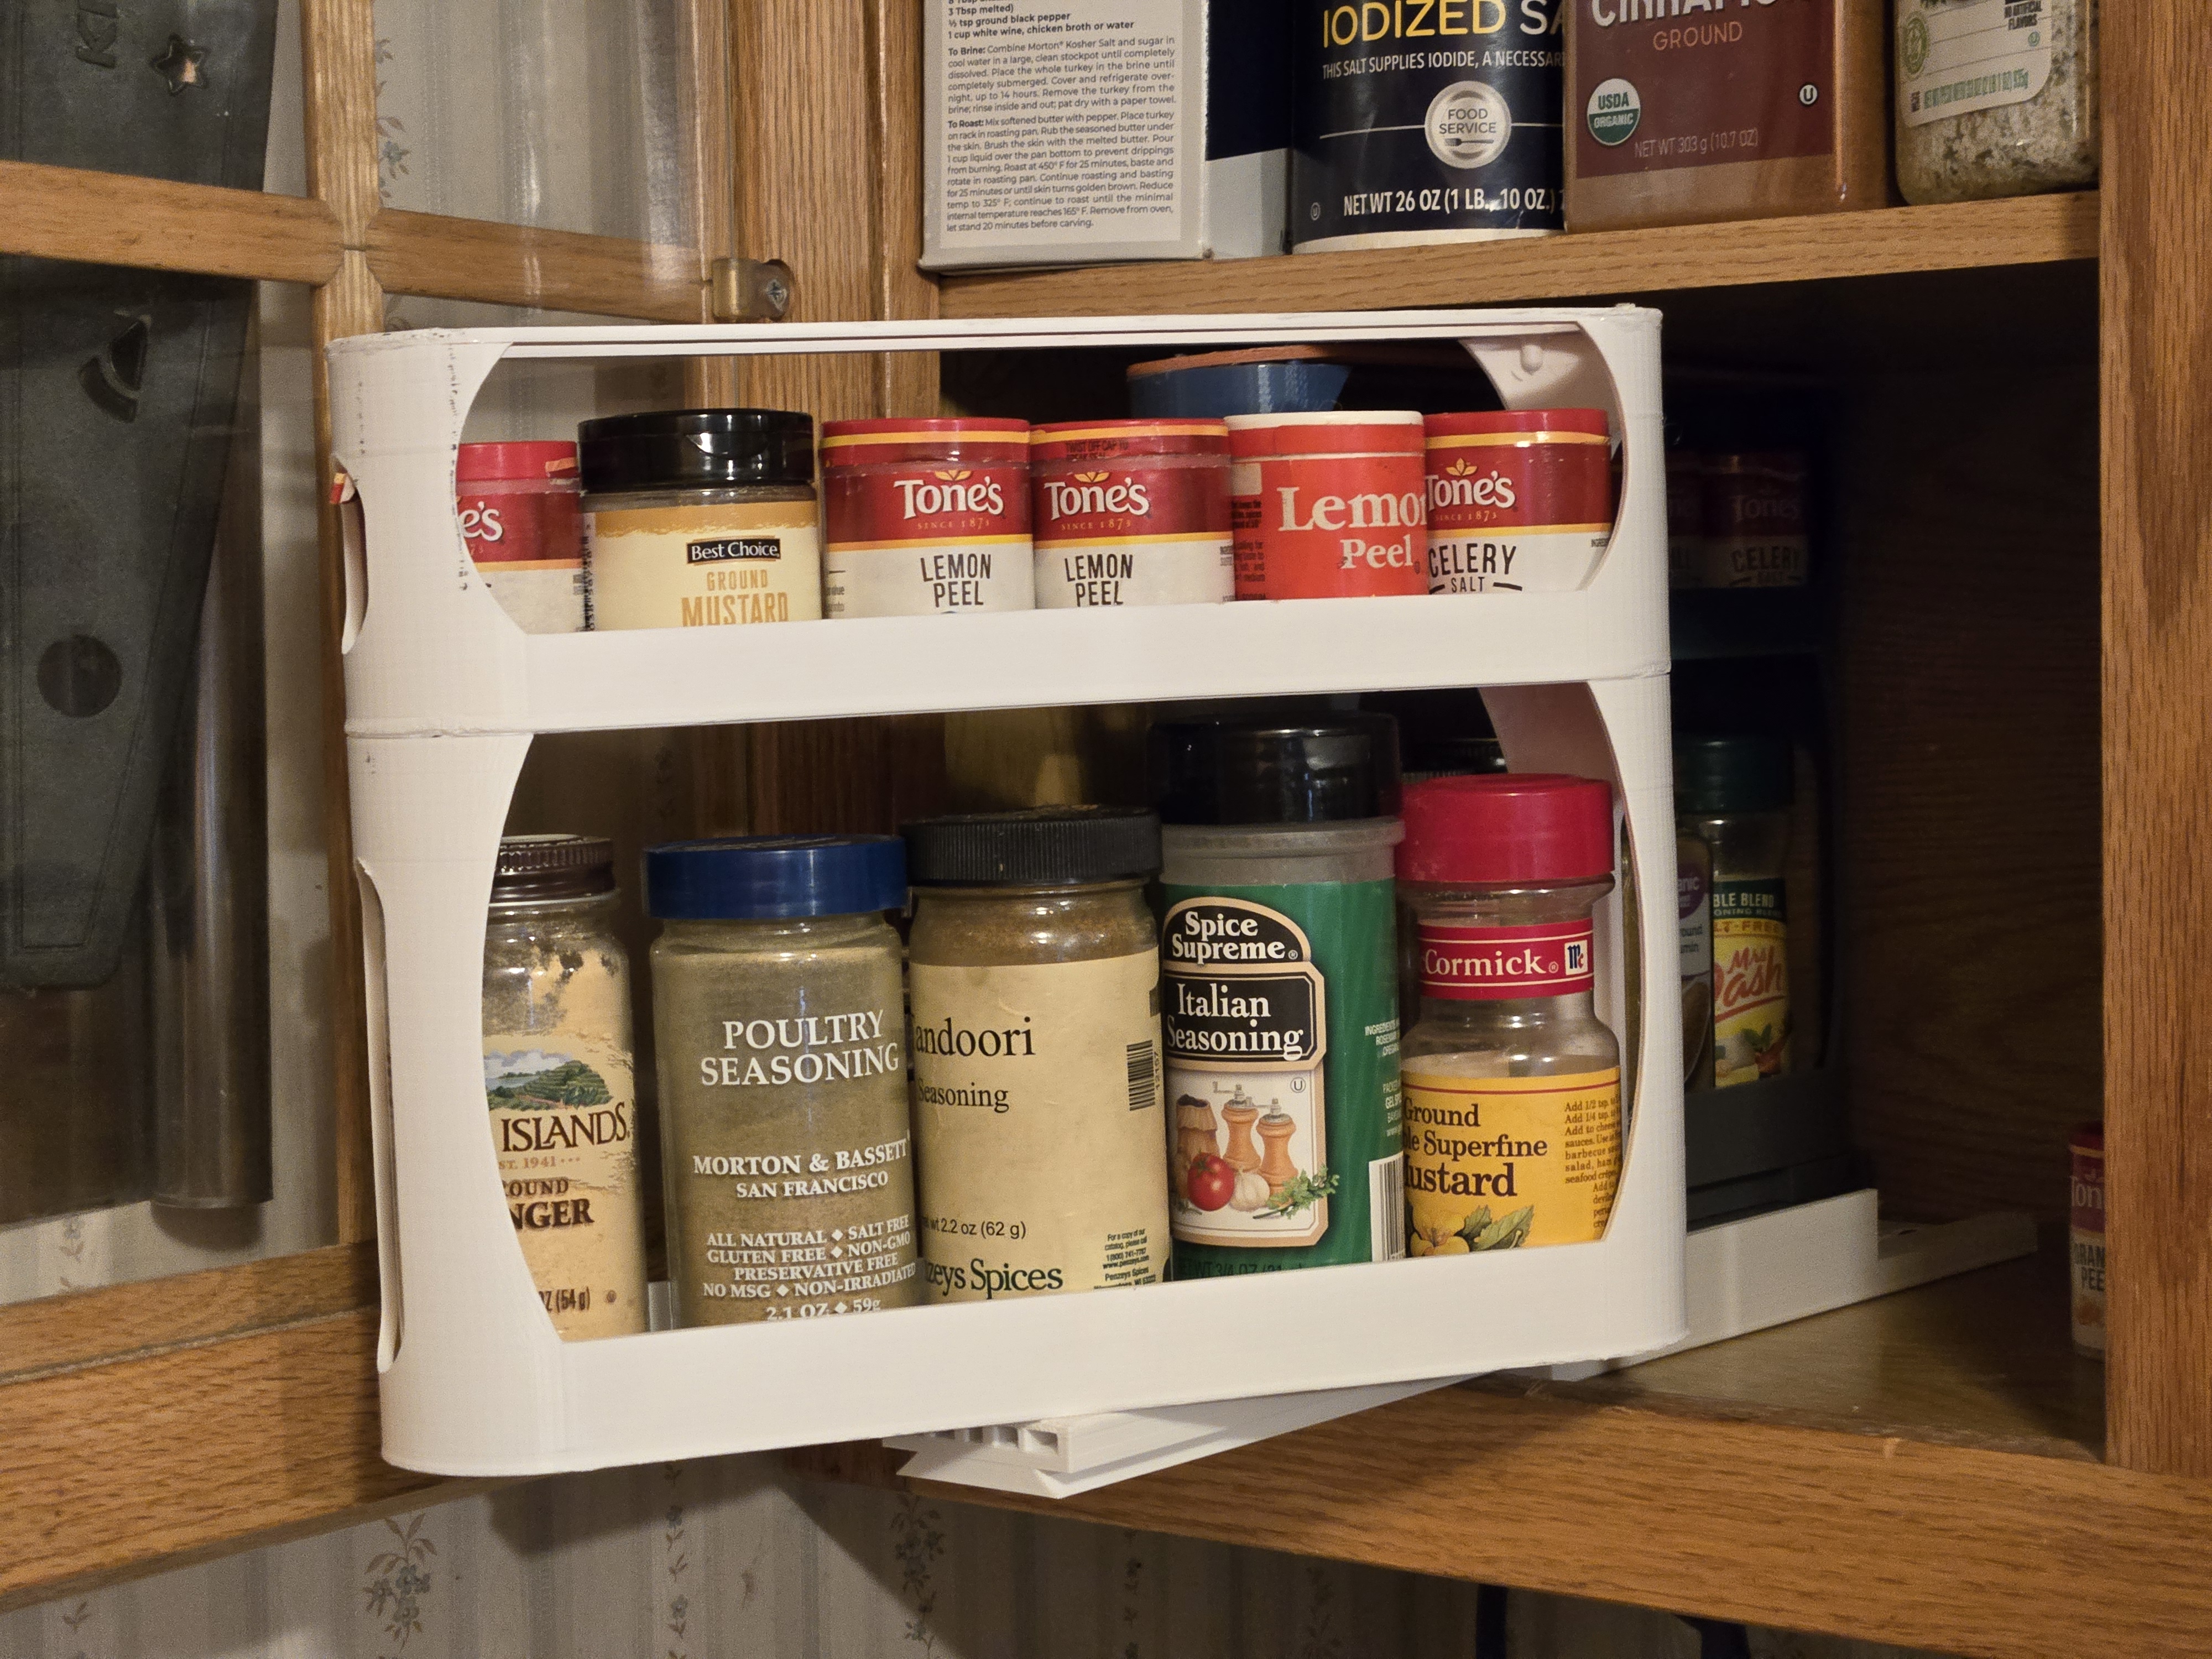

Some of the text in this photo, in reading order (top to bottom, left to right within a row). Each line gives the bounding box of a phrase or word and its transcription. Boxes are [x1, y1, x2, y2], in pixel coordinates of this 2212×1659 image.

[956, 7, 977, 15] Tbsp
[979, 3, 1014, 13] melted)
[976, 15, 1008, 27] ground
[1011, 14, 1035, 23] black
[1037, 13, 1072, 23] pepper
[973, 28, 998, 37] white
[1000, 27, 1025, 35] wine,
[1027, 24, 1062, 34] chicken
[1066, 23, 1091, 32] broth
[1324, 0, 1506, 48] IODIZED
[1652, 21, 1743, 51] GROUND
[948, 48, 958, 56] To
[961, 46, 985, 55] Brine:
[987, 44, 1025, 54] Combine
[1066, 39, 1096, 49] Kosher
[1099, 38, 1115, 48] Salt
[1118, 37, 1135, 46] and
[1138, 36, 1163, 47] sugar
[1166, 35, 1175, 44] in
[948, 59, 965, 67] cool
[967, 58, 990, 66] water
[993, 56, 1000, 65] in
[1010, 56, 1034, 65] large,
[1035, 54, 1058, 62] clean
[1061, 51, 1099, 61] stockpot
[1102, 49, 1121, 58] until
[1124, 47, 1175, 59] completely
[1323, 64, 1342, 80] THIS
[1344, 61, 1365, 77] SALT
[1369, 53, 1424, 72] SUPPLIES
[1429, 51, 1478, 69] IODIDE,
[1483, 51, 1492, 65] A
[1598, 91, 1630, 109] USDA
[1448, 108, 1488, 121] FOOD
[1593, 114, 1634, 129] ORGANIC
[1439, 122, 1496, 135] SERVICE
[1635, 127, 1759, 158] NET WT 303 g (10.7 OZ)
[1344, 192, 1366, 216] NET
[1370, 191, 1392, 213] WT
[1396, 191, 1415, 212] 26
[1420, 190, 1441, 211] OZ
[1444, 189, 1459, 215] (1
[1500, 188, 1520, 210] 10
[1524, 188, 1555, 213] OZ.)
[958, 222, 981, 231] stand
[983, 222, 993, 230] 20
[995, 221, 1029, 229] minutes
[1030, 219, 1057, 228] before
[1060, 218, 1094, 228] carving.
[893, 476, 1005, 520] Tone's
[1044, 477, 1152, 521] Tone's
[1426, 471, 1516, 512] Tone's
[457, 500, 504, 542] e's
[917, 521, 954, 530] SINCE
[1061, 521, 1094, 531] SINCE
[691, 539, 779, 560] Best Choice
[1340, 534, 1414, 570] Peel
[1428, 544, 1517, 578] CELERY
[706, 570, 768, 592] GROUND
[920, 554, 992, 582] LEMON
[1065, 554, 1134, 583] LEMON
[933, 581, 984, 607] PEEL
[1076, 582, 1124, 607] PEEL
[1451, 577, 1485, 594] SALT
[681, 592, 789, 628] MUSTARD
[1740, 893, 1775, 908] BLEND
[1185, 911, 1259, 941] Spice
[1172, 933, 1286, 965] Supreme
[1425, 948, 1547, 977] Cormick
[1177, 983, 1271, 1018] Italian
[722, 1009, 884, 1050] POULTRY
[915, 1015, 1036, 1057] andoori
[1167, 1015, 1304, 1061] Seasoning
[700, 1042, 899, 1086] SEASONING
[917, 1077, 1010, 1114] Seasoning
[1564, 1100, 1583, 1112] Add
[1585, 1099, 1597, 1110] 1/2
[1404, 1098, 1481, 1128] Ground
[1564, 1113, 1583, 1124] Add
[1564, 1125, 1595, 1136] Add to
[1423, 1134, 1548, 1161] Superfine
[1564, 1148, 1606, 1160] barbecue
[524, 1155, 556, 1169] 1941
[692, 1155, 801, 1176] MORTON
[808, 1152, 830, 1173] &
[1564, 1160, 1594, 1172] salad,
[736, 1170, 889, 1199] SAN FRANCISCO
[1564, 1170, 1597, 1183] seafood
[707, 1214, 910, 1248] ALL NATURAL SALT FREE
[941, 1218, 959, 1234] 2.2
[961, 1223, 978, 1235] oz
[980, 1220, 1005, 1239] (62
[1010, 1220, 1027, 1239] g)
[707, 1230, 911, 1265] GLUTEN FREE NON-GMO
[734, 1252, 899, 1282] PRESERVATIVE FREE
[971, 1258, 1064, 1300] Spices
[556, 1288, 577, 1313] (54
[578, 1286, 591, 1311] g)
[703, 1283, 726, 1298] NO
[731, 1284, 772, 1299] MSG
[766, 1306, 792, 1321] 2.1
[852, 1297, 881, 1313] 59g
